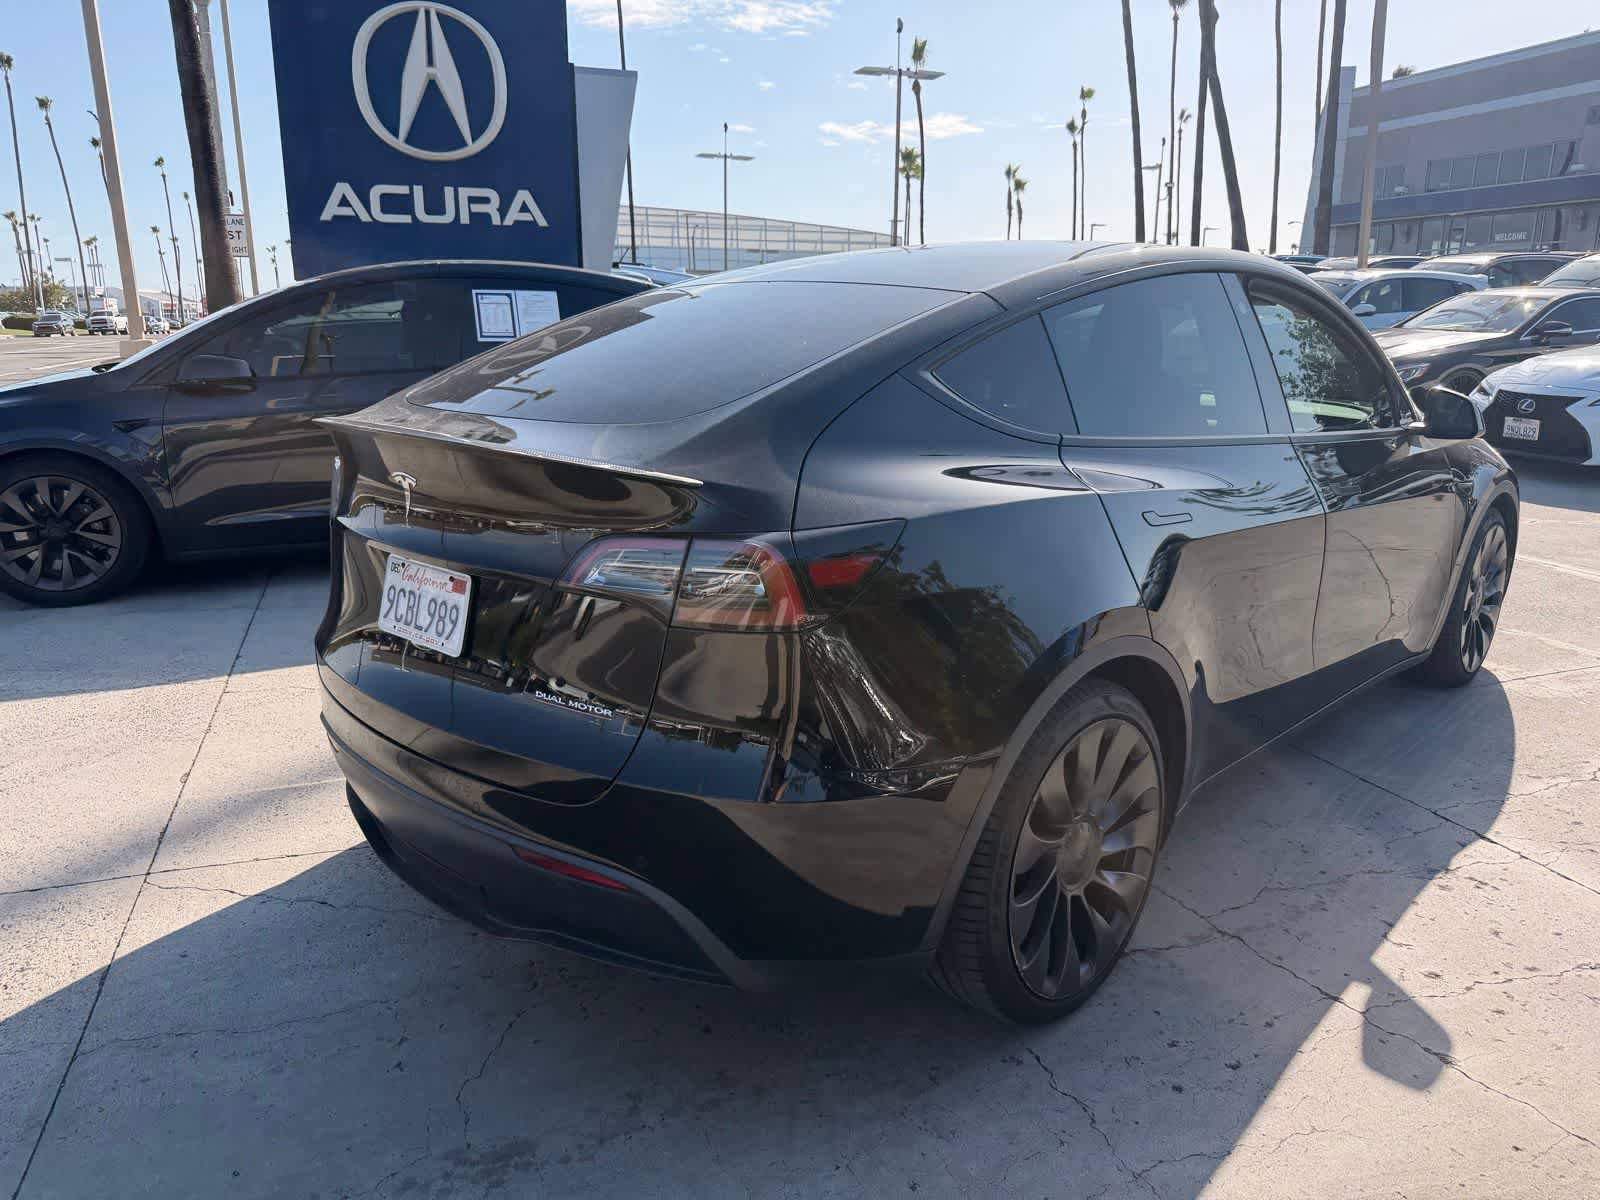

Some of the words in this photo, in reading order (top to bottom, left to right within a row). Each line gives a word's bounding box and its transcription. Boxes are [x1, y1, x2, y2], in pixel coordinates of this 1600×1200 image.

[319, 182, 549, 227] ACURA
[231, 246, 248, 254] IGHT
[1495, 231, 1528, 241] WELCOME
[390, 561, 401, 574] DEC
[401, 563, 454, 594] California
[383, 585, 460, 641] 9CBL989
[535, 690, 566, 705] DUAL
[568, 700, 613, 717] MOTOR
